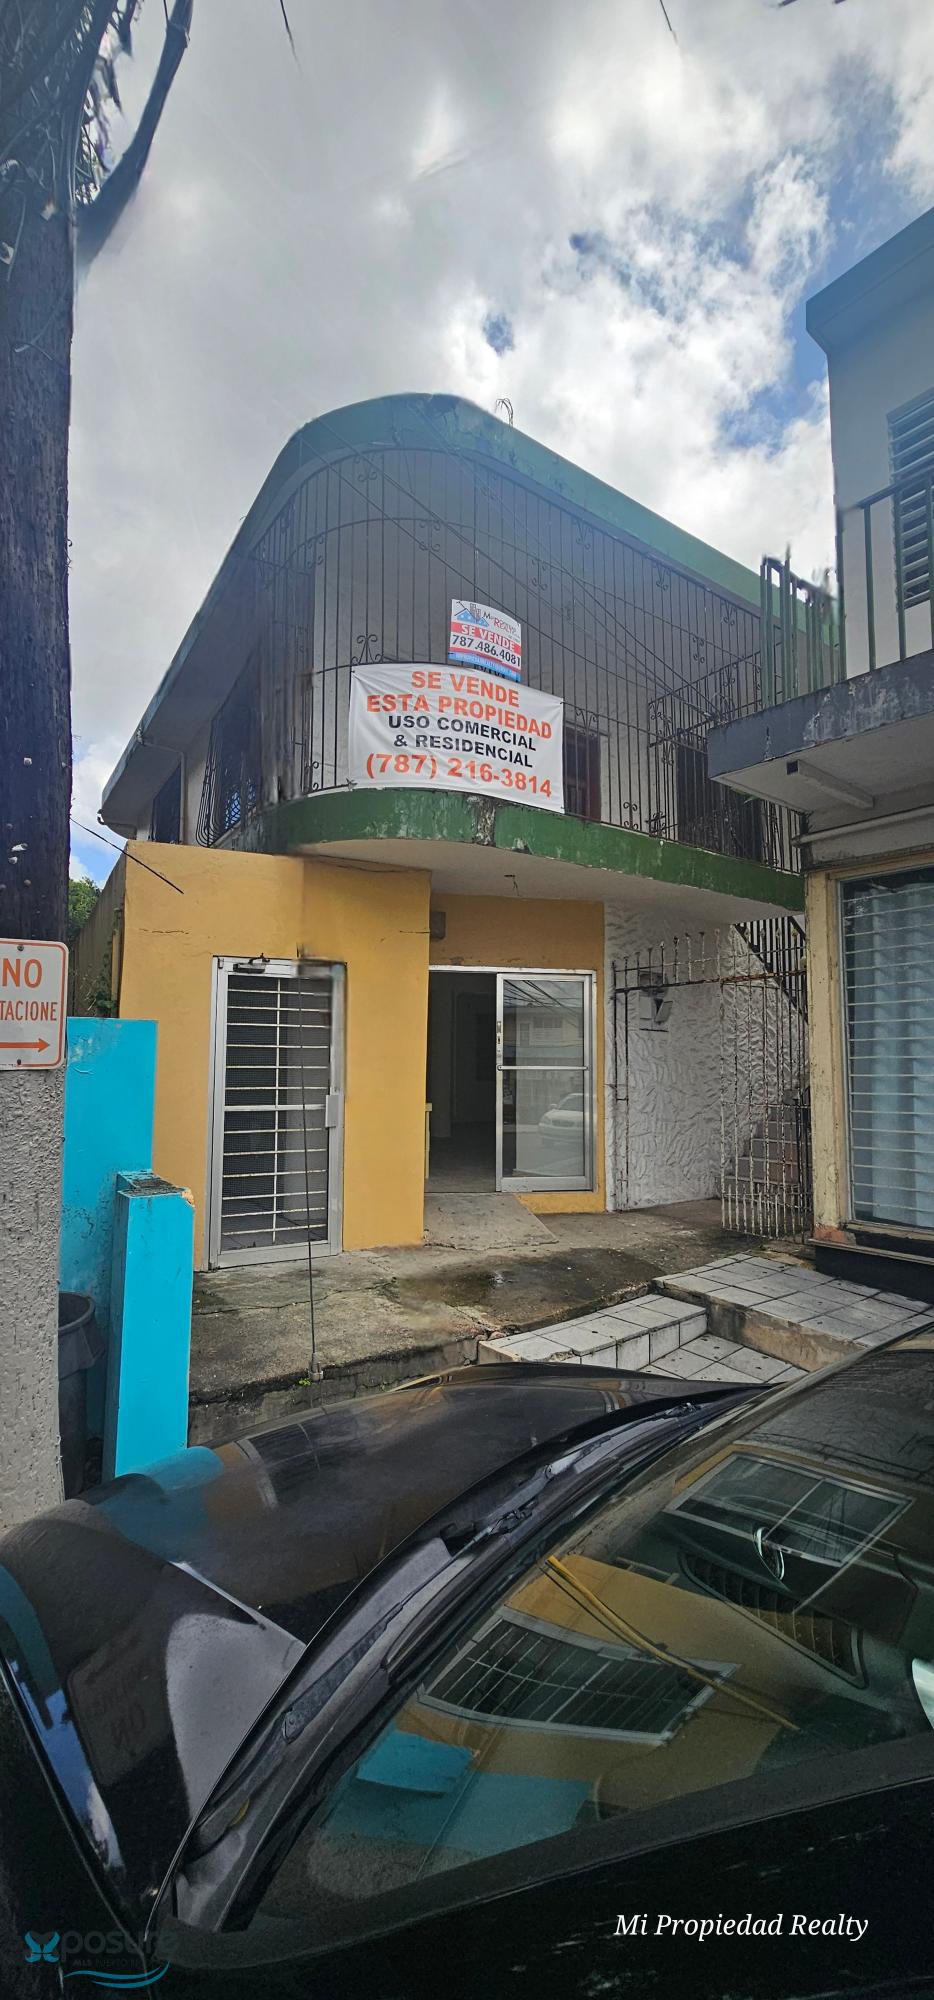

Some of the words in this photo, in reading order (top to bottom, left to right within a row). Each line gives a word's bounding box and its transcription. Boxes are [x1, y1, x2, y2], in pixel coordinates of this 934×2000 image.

[452, 634, 521, 667] 787.486.4081
[461, 624, 476, 636] SE
[480, 628, 515, 651] VENDE
[411, 671, 442, 690] SE
[450, 673, 520, 708] VENDE
[366, 693, 430, 713] ESTA
[438, 695, 553, 740] PROPIEDAD
[388, 715, 430, 729] USO
[437, 716, 537, 752] COMERCIAL
[393, 734, 408, 748] &
[415, 734, 533, 768] RESIDENCIAL
[366, 753, 438, 779] (787)
[447, 757, 552, 798] 216-3814
[2, 958, 42, 988] NO
[0, 1000, 58, 1021] TACIONE
